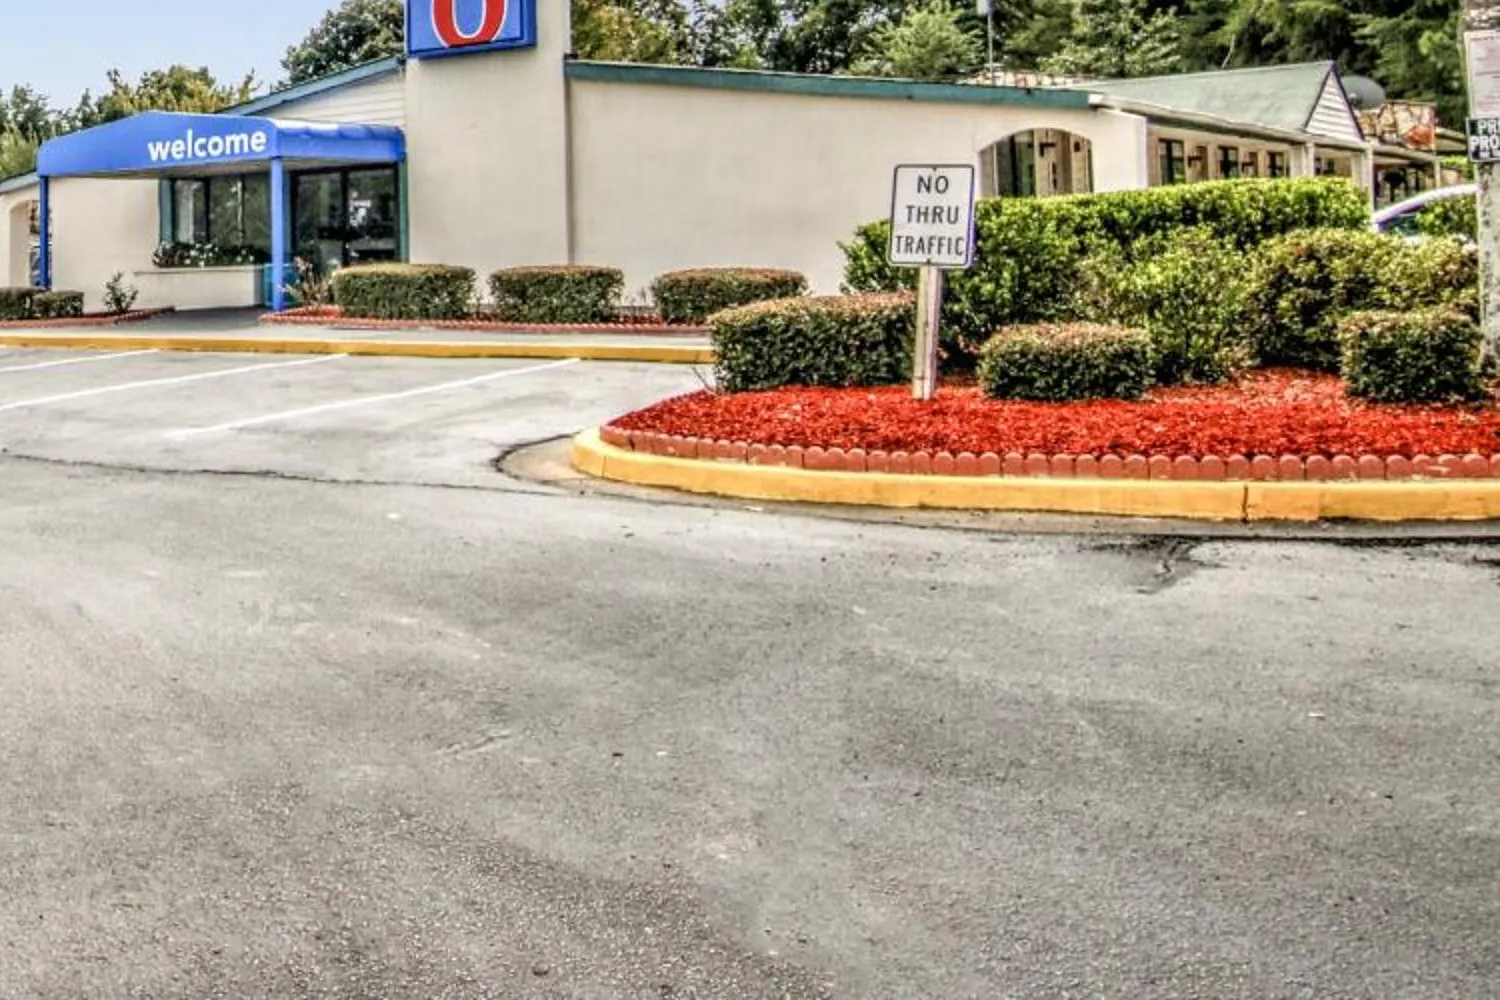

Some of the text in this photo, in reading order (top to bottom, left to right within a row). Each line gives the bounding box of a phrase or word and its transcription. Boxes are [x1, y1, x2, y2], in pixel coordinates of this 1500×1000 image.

[147, 127, 268, 162] welcome
[917, 175, 949, 194] NO
[906, 205, 959, 225] THRU
[895, 235, 964, 256] TRAFFIC
